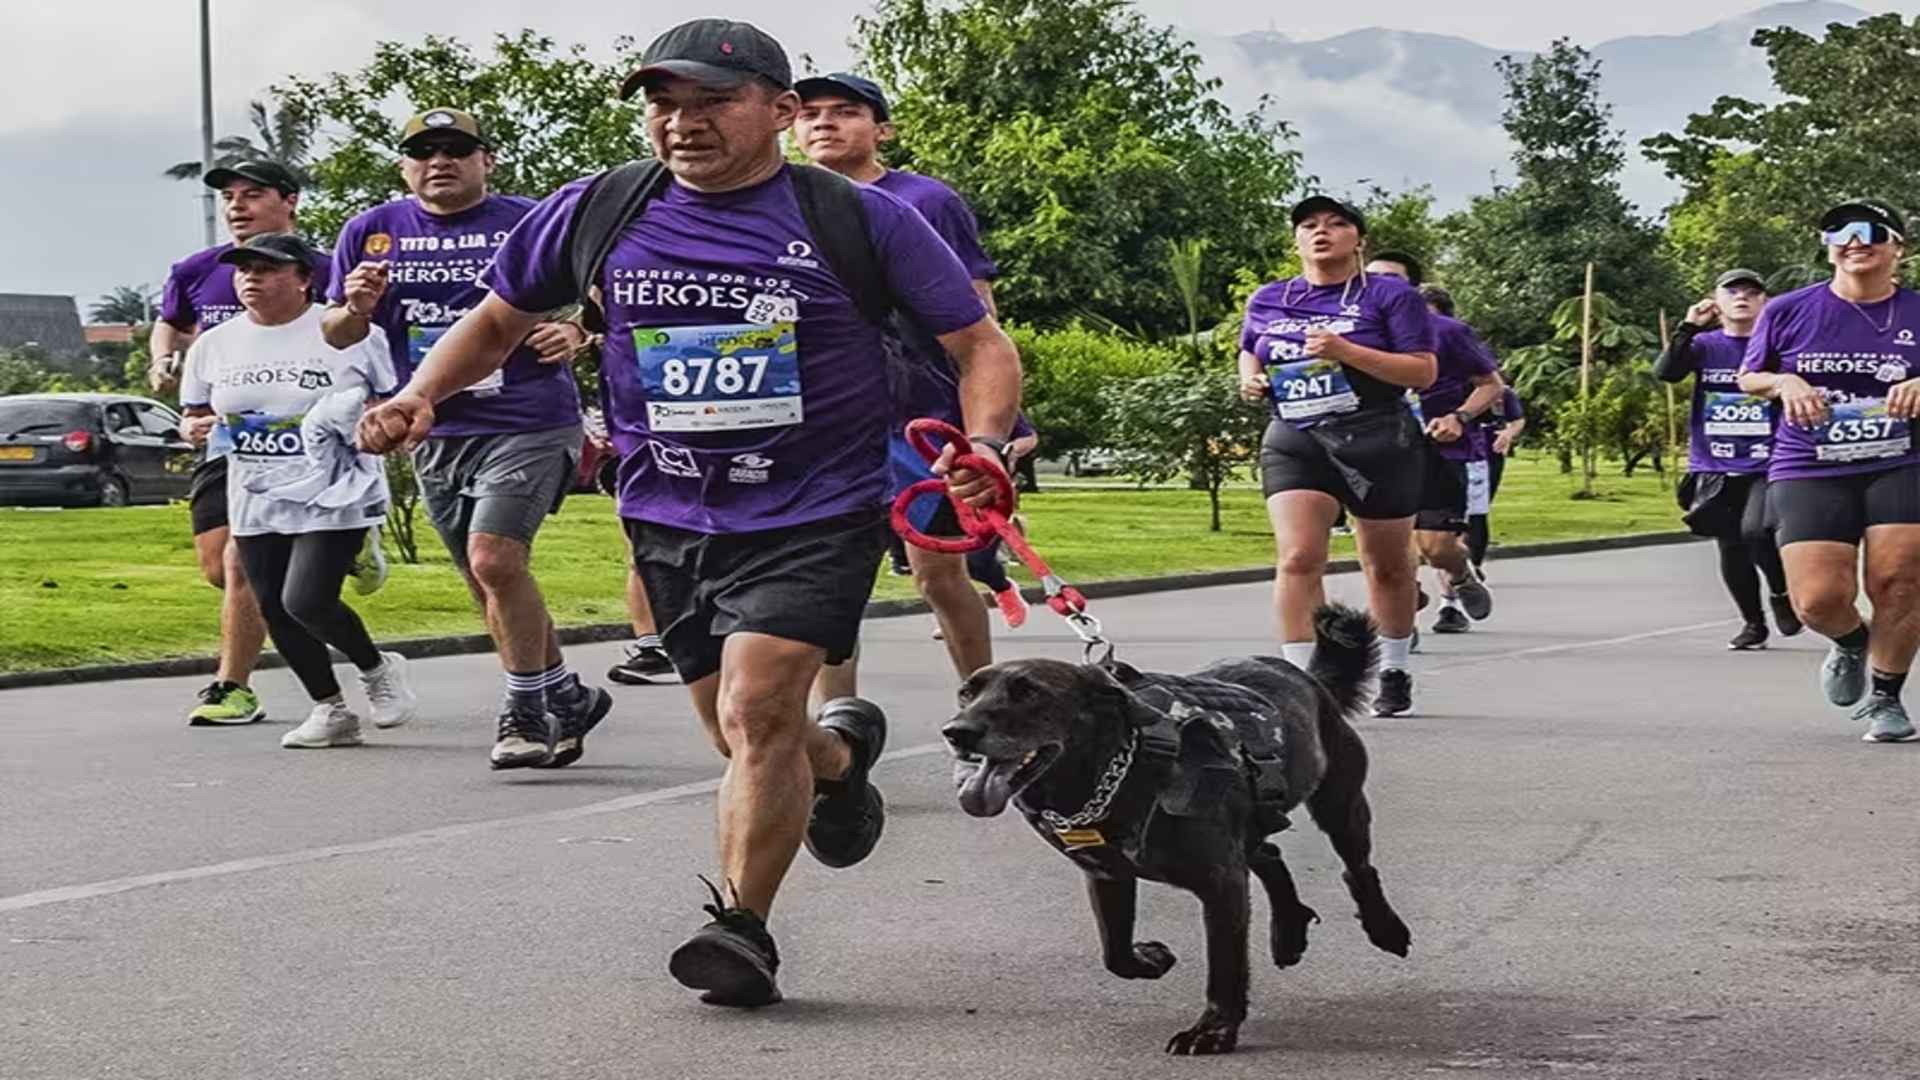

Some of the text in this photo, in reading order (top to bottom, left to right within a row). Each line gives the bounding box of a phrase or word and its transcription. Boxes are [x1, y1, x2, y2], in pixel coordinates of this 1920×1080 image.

[400, 233, 487, 251] TITO & LIA
[387, 266, 476, 284] HÉROES
[613, 268, 791, 289] CARRERA POR LOS
[613, 280, 750, 309] HÉROES
[662, 355, 769, 396] 8787
[1796, 358, 1879, 374] HÉROES
[1282, 373, 1333, 400] 2947
[1711, 405, 1763, 421] 3098
[1828, 417, 1893, 442] 6357
[237, 430, 301, 454] 2660
